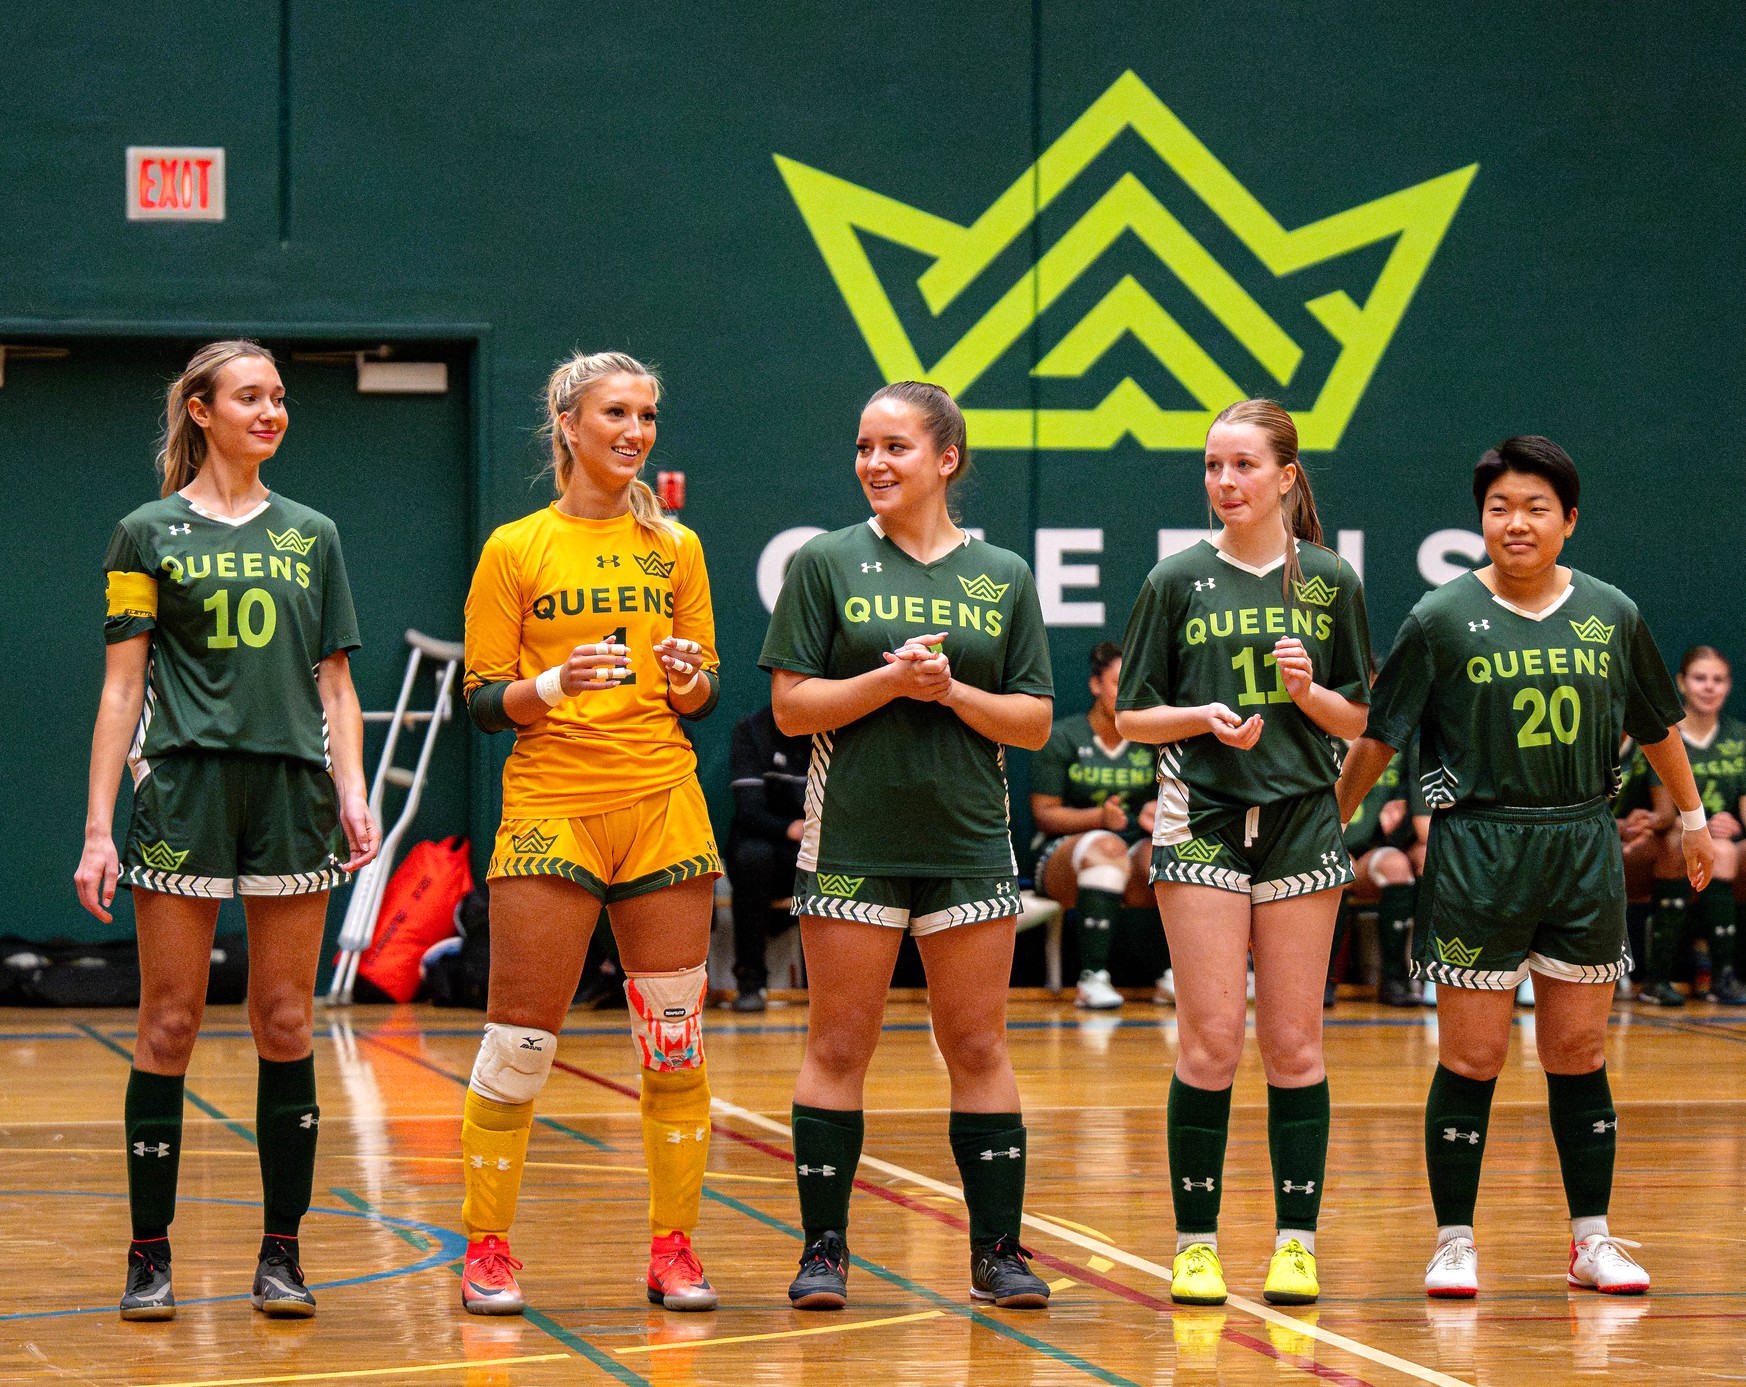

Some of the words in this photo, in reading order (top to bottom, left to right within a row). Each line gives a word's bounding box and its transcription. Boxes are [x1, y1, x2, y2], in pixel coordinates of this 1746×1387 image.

[139, 159, 212, 209] EXIT
[161, 552, 311, 589] QUEENS
[203, 588, 277, 649] 10
[533, 586, 674, 620] QUEENS
[844, 595, 1003, 637] QUEENS
[1186, 607, 1333, 645] QUEENS
[1231, 646, 1294, 706] 11
[1466, 648, 1611, 684] QUEENS
[1512, 685, 1581, 749] 20
